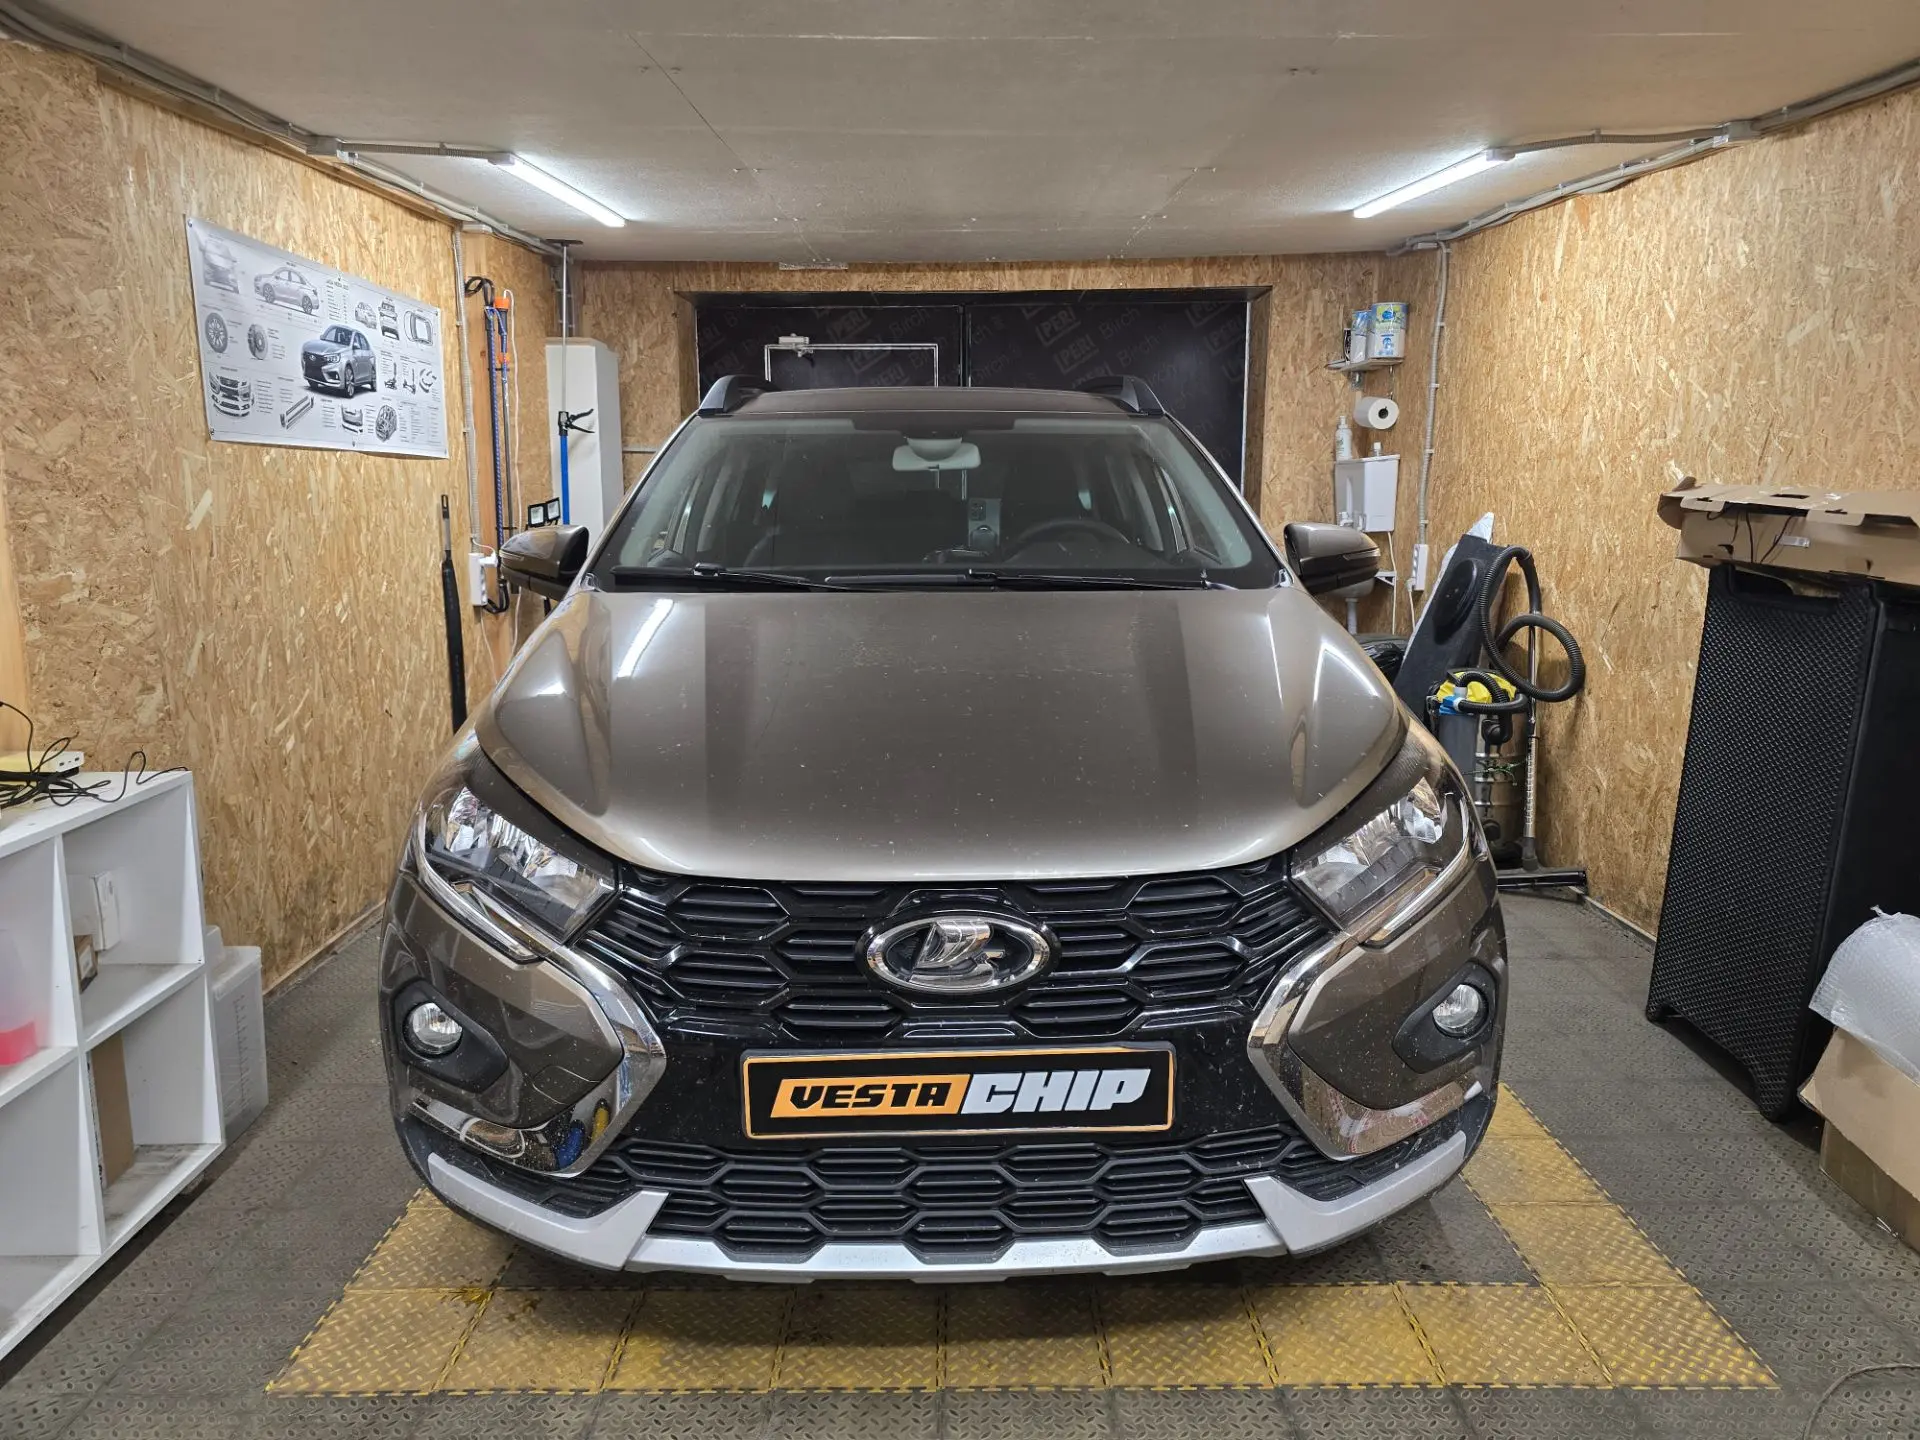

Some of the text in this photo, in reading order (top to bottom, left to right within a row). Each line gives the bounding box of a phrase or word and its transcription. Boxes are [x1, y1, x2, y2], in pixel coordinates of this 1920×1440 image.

[889, 307, 931, 337] Birch
[1040, 306, 1077, 338] PERI
[1059, 307, 1141, 367] PERI Birch
[1116, 333, 1160, 368] Birch
[789, 1069, 1152, 1115] VESTA CHIP
